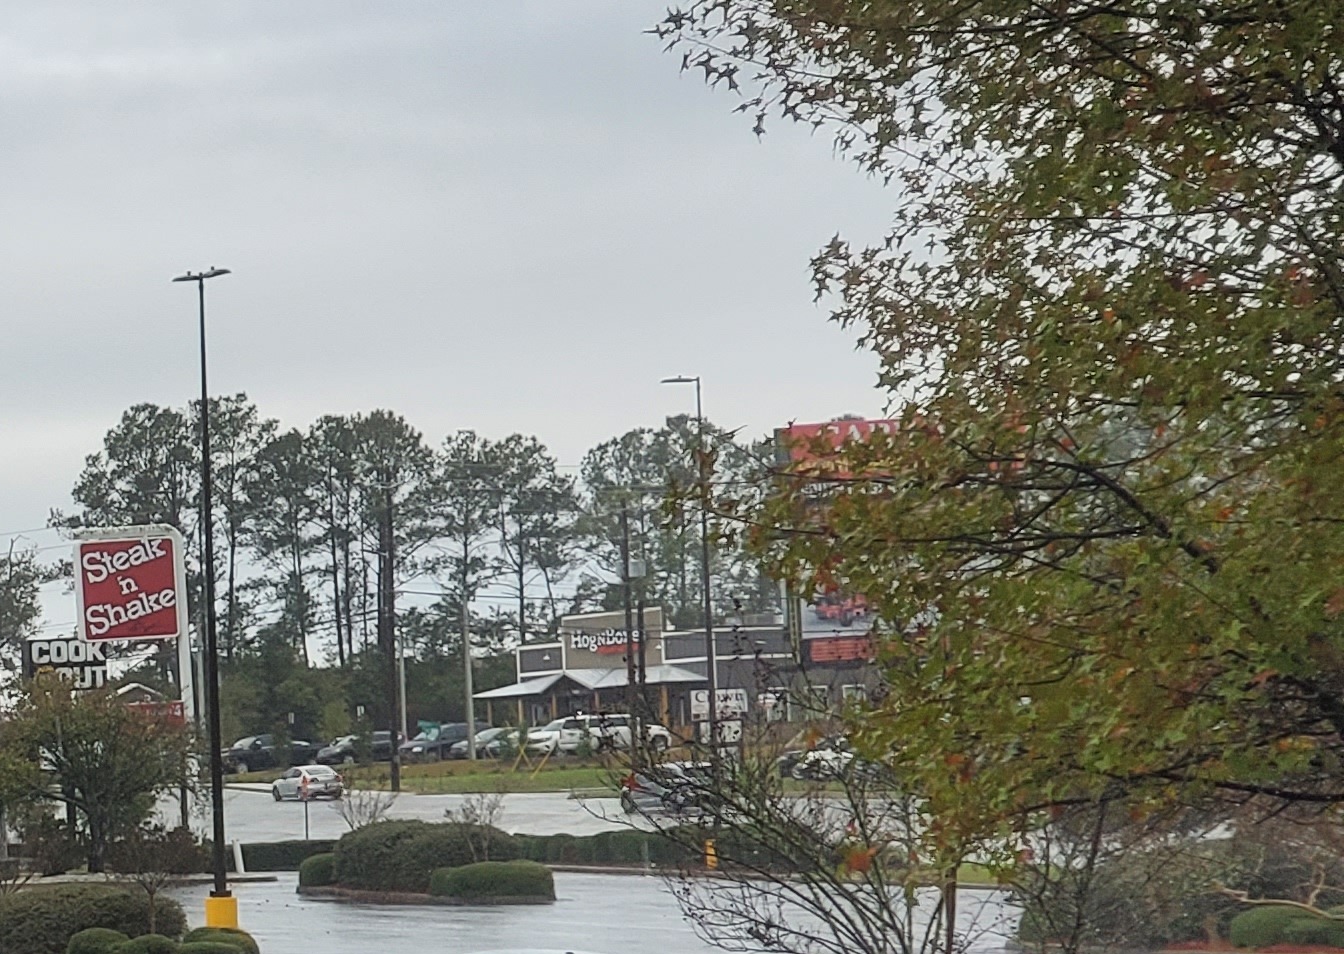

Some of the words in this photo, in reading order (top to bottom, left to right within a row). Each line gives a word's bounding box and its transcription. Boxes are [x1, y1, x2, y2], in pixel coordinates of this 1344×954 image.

[82, 539, 166, 584] Steak
[117, 575, 139, 595] 'n
[85, 588, 176, 636] Shake
[30, 640, 107, 664] COOK
